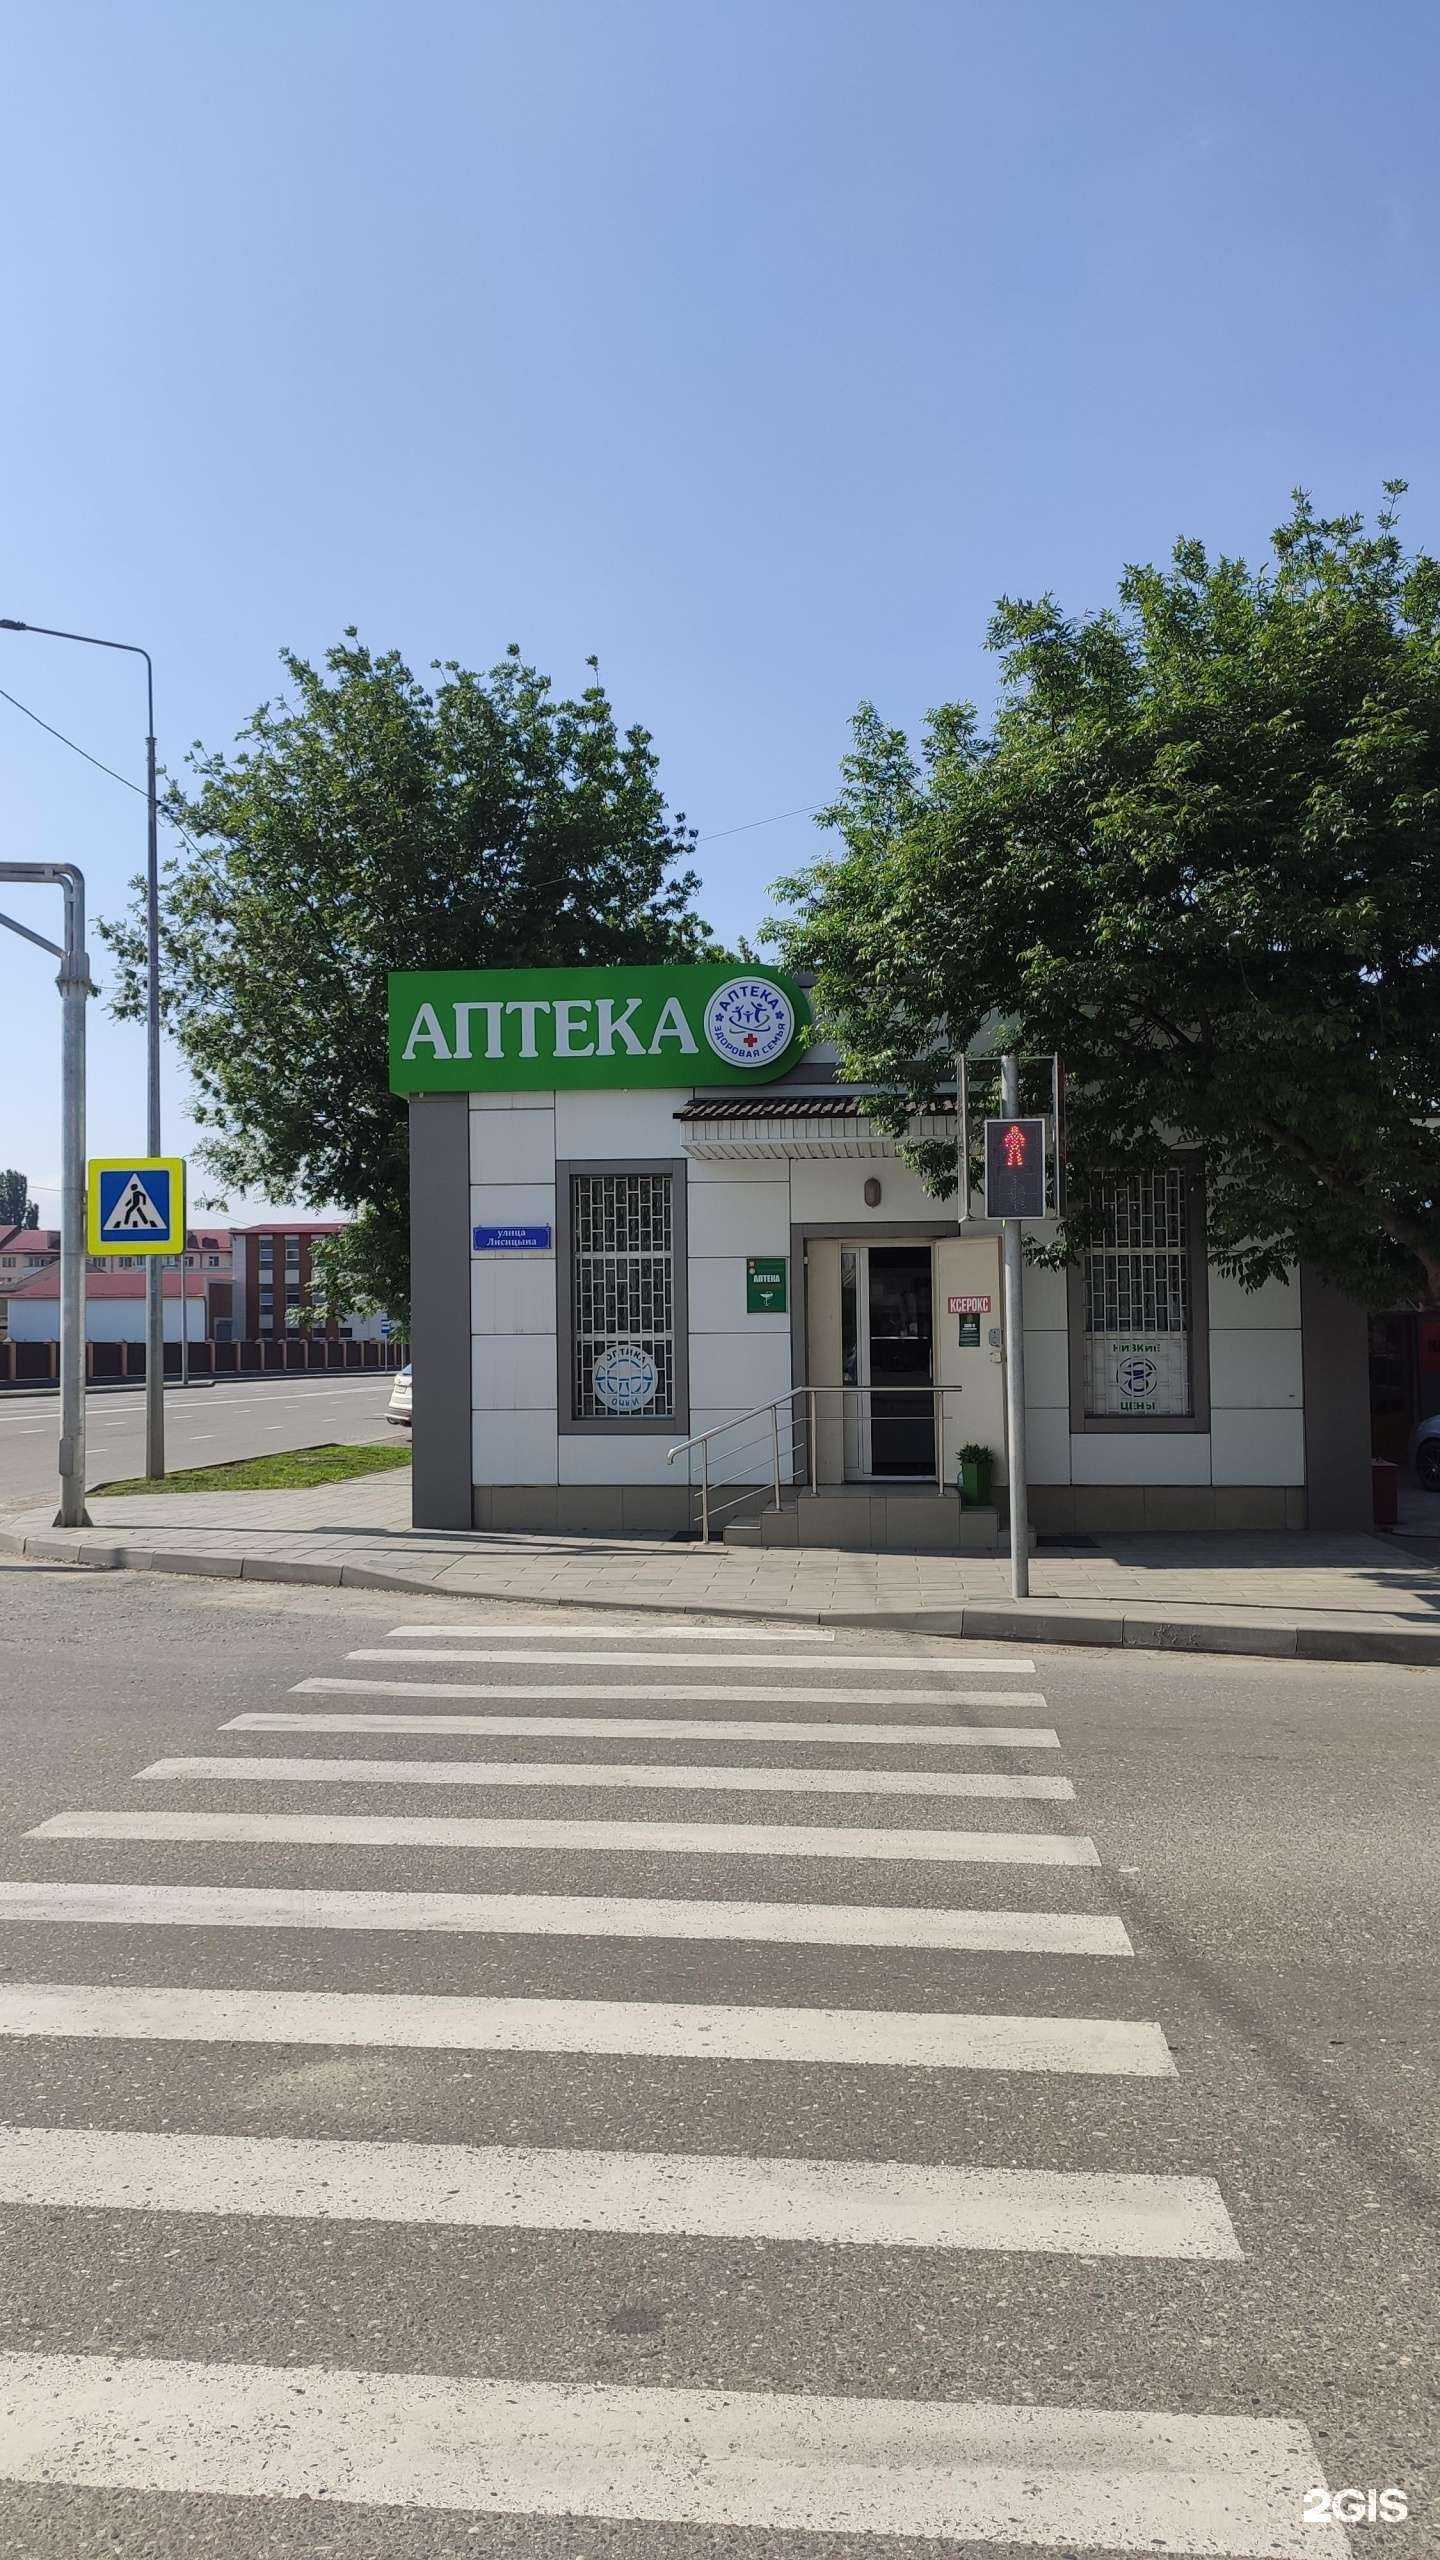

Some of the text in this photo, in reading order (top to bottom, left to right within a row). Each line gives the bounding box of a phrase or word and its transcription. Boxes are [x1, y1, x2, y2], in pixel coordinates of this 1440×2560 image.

[719, 986, 779, 1011] АПТЕКА
[402, 997, 699, 1060] АПТЕКА
[714, 1023, 786, 1058] ЗДОРОВАЯ СЕМЬЯ
[497, 1229, 526, 1238] улица
[753, 1274, 780, 1283] АПТЕКА
[950, 1297, 989, 1312] КСЕРОКС
[1120, 1402, 1155, 1411] ЦЕНЫ
